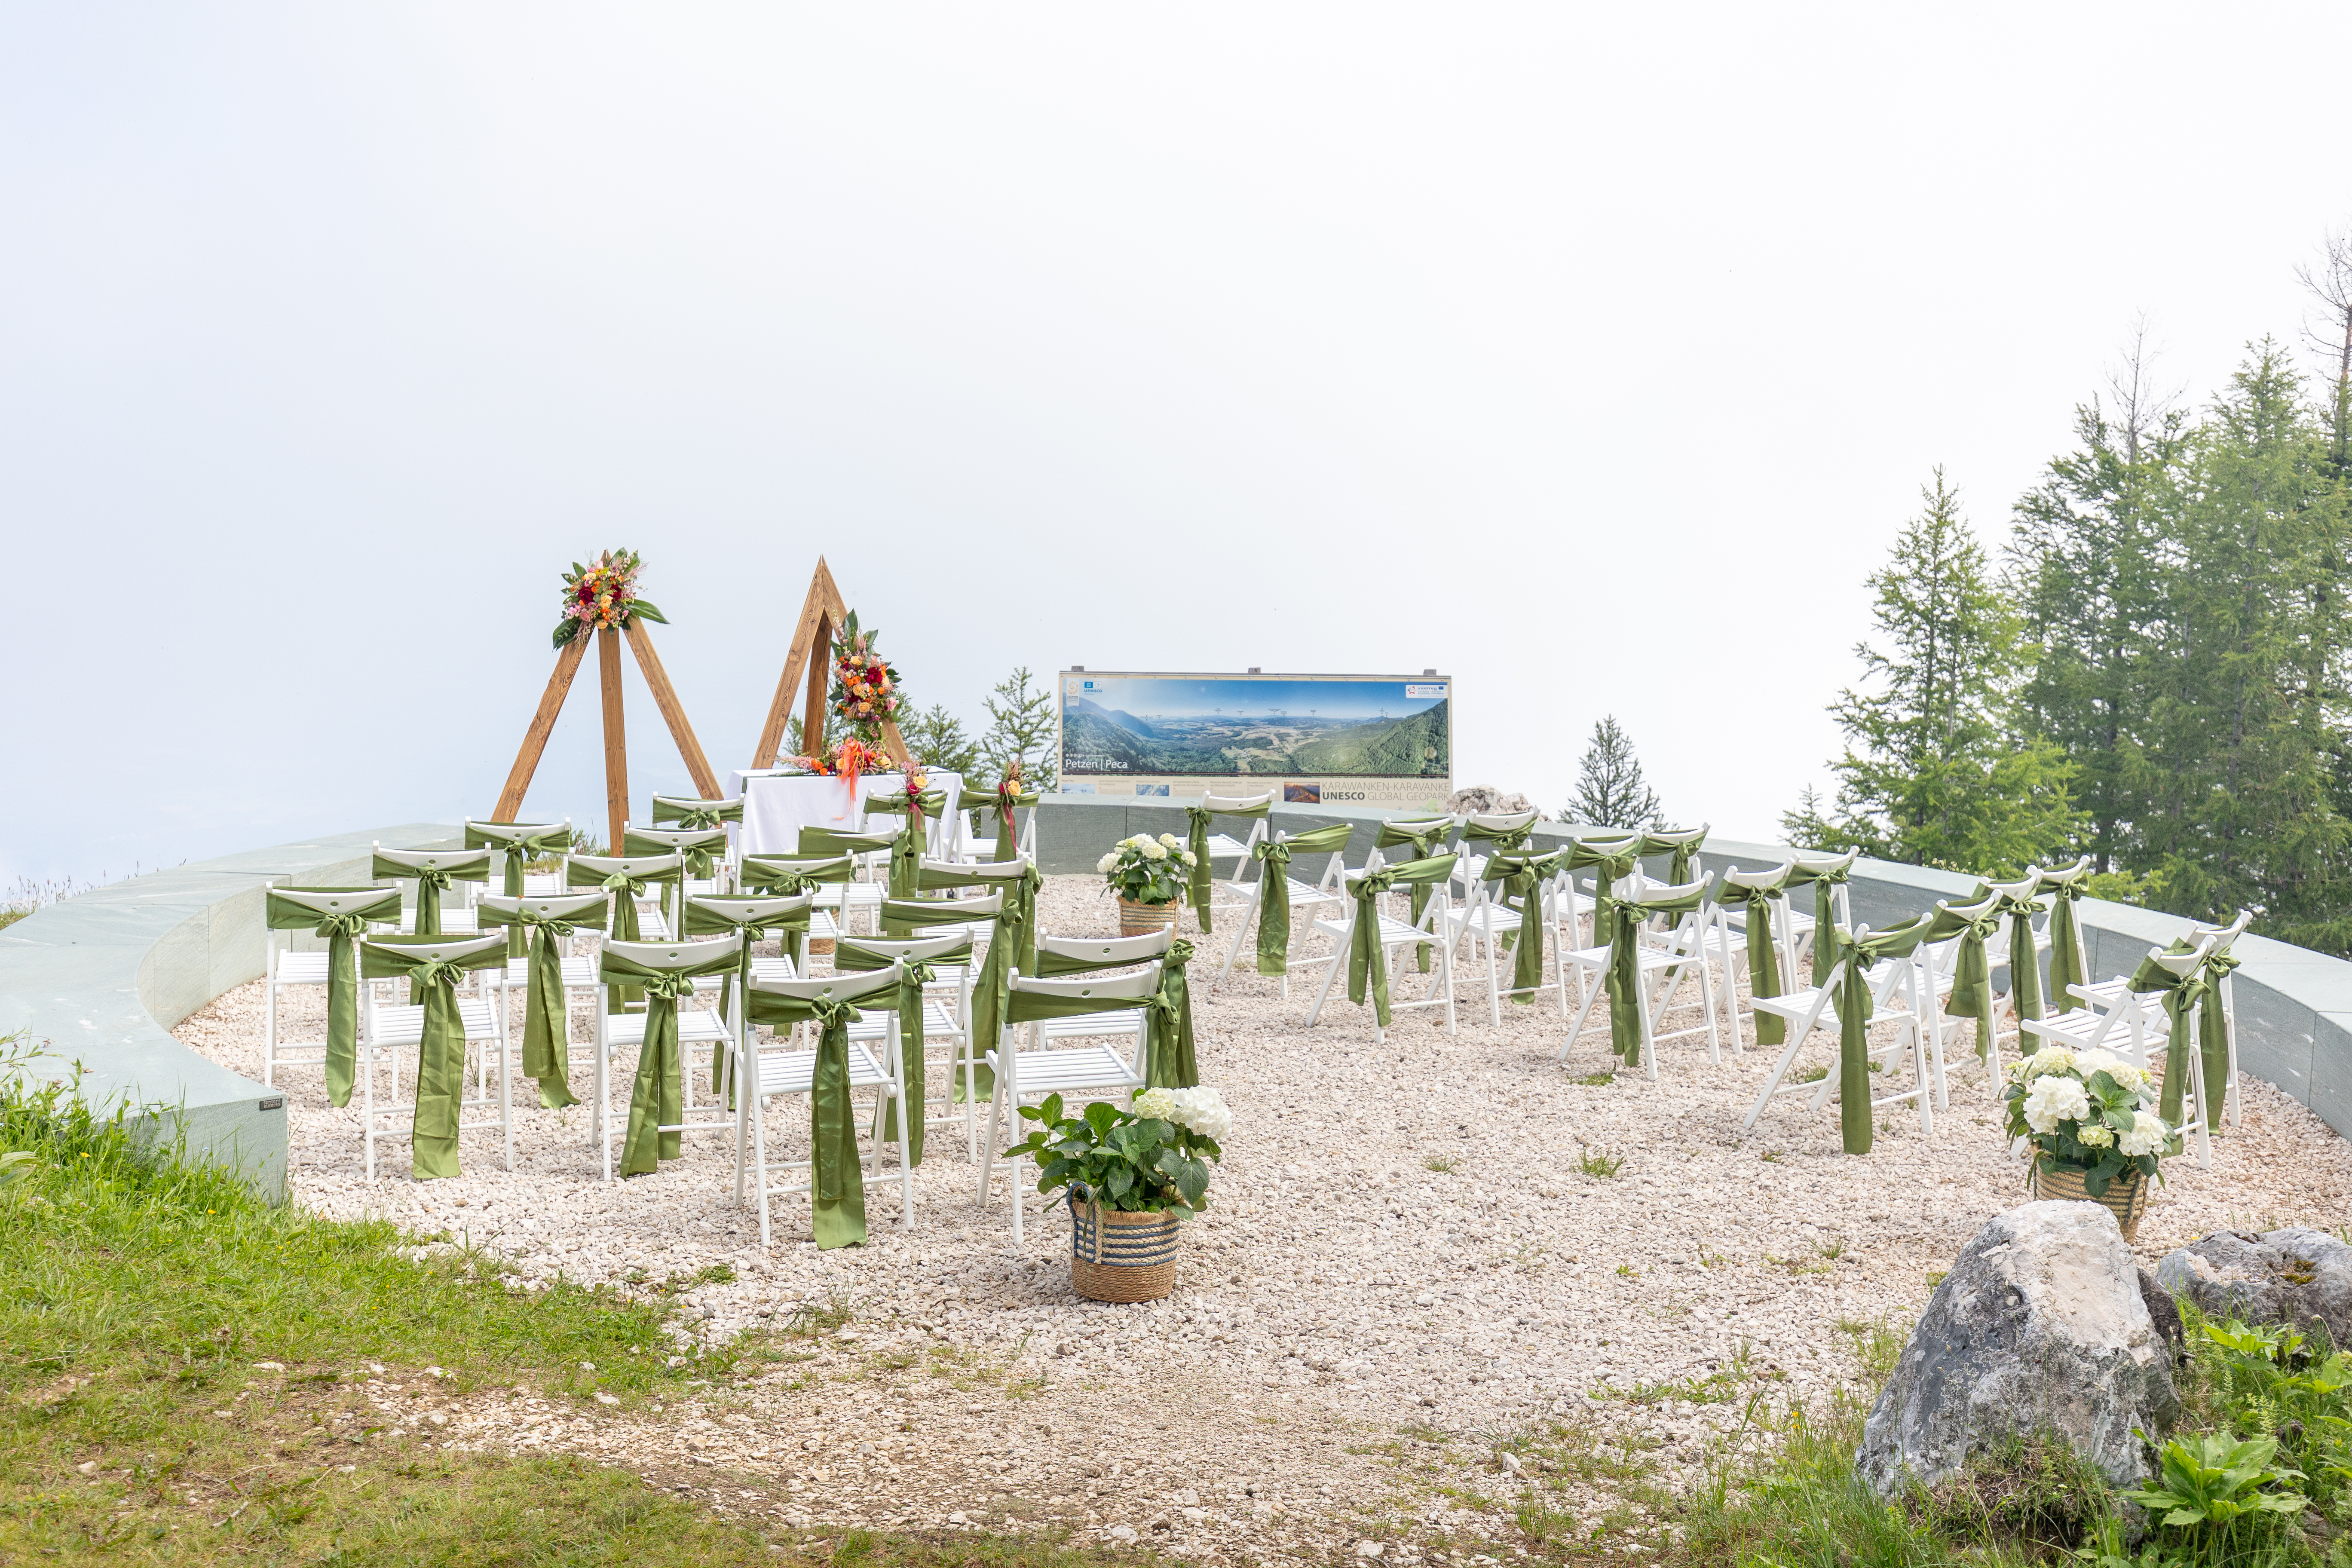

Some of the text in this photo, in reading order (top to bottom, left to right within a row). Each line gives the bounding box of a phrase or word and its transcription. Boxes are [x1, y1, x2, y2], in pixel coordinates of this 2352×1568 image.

[1066, 759, 1097, 768] Petzen
[1106, 760, 1127, 769] Peca
[1322, 781, 1449, 791] KARAWANKEN-KARAVANKE
[1323, 792, 1449, 801] UNESCO GLOBAL GEOPARK
